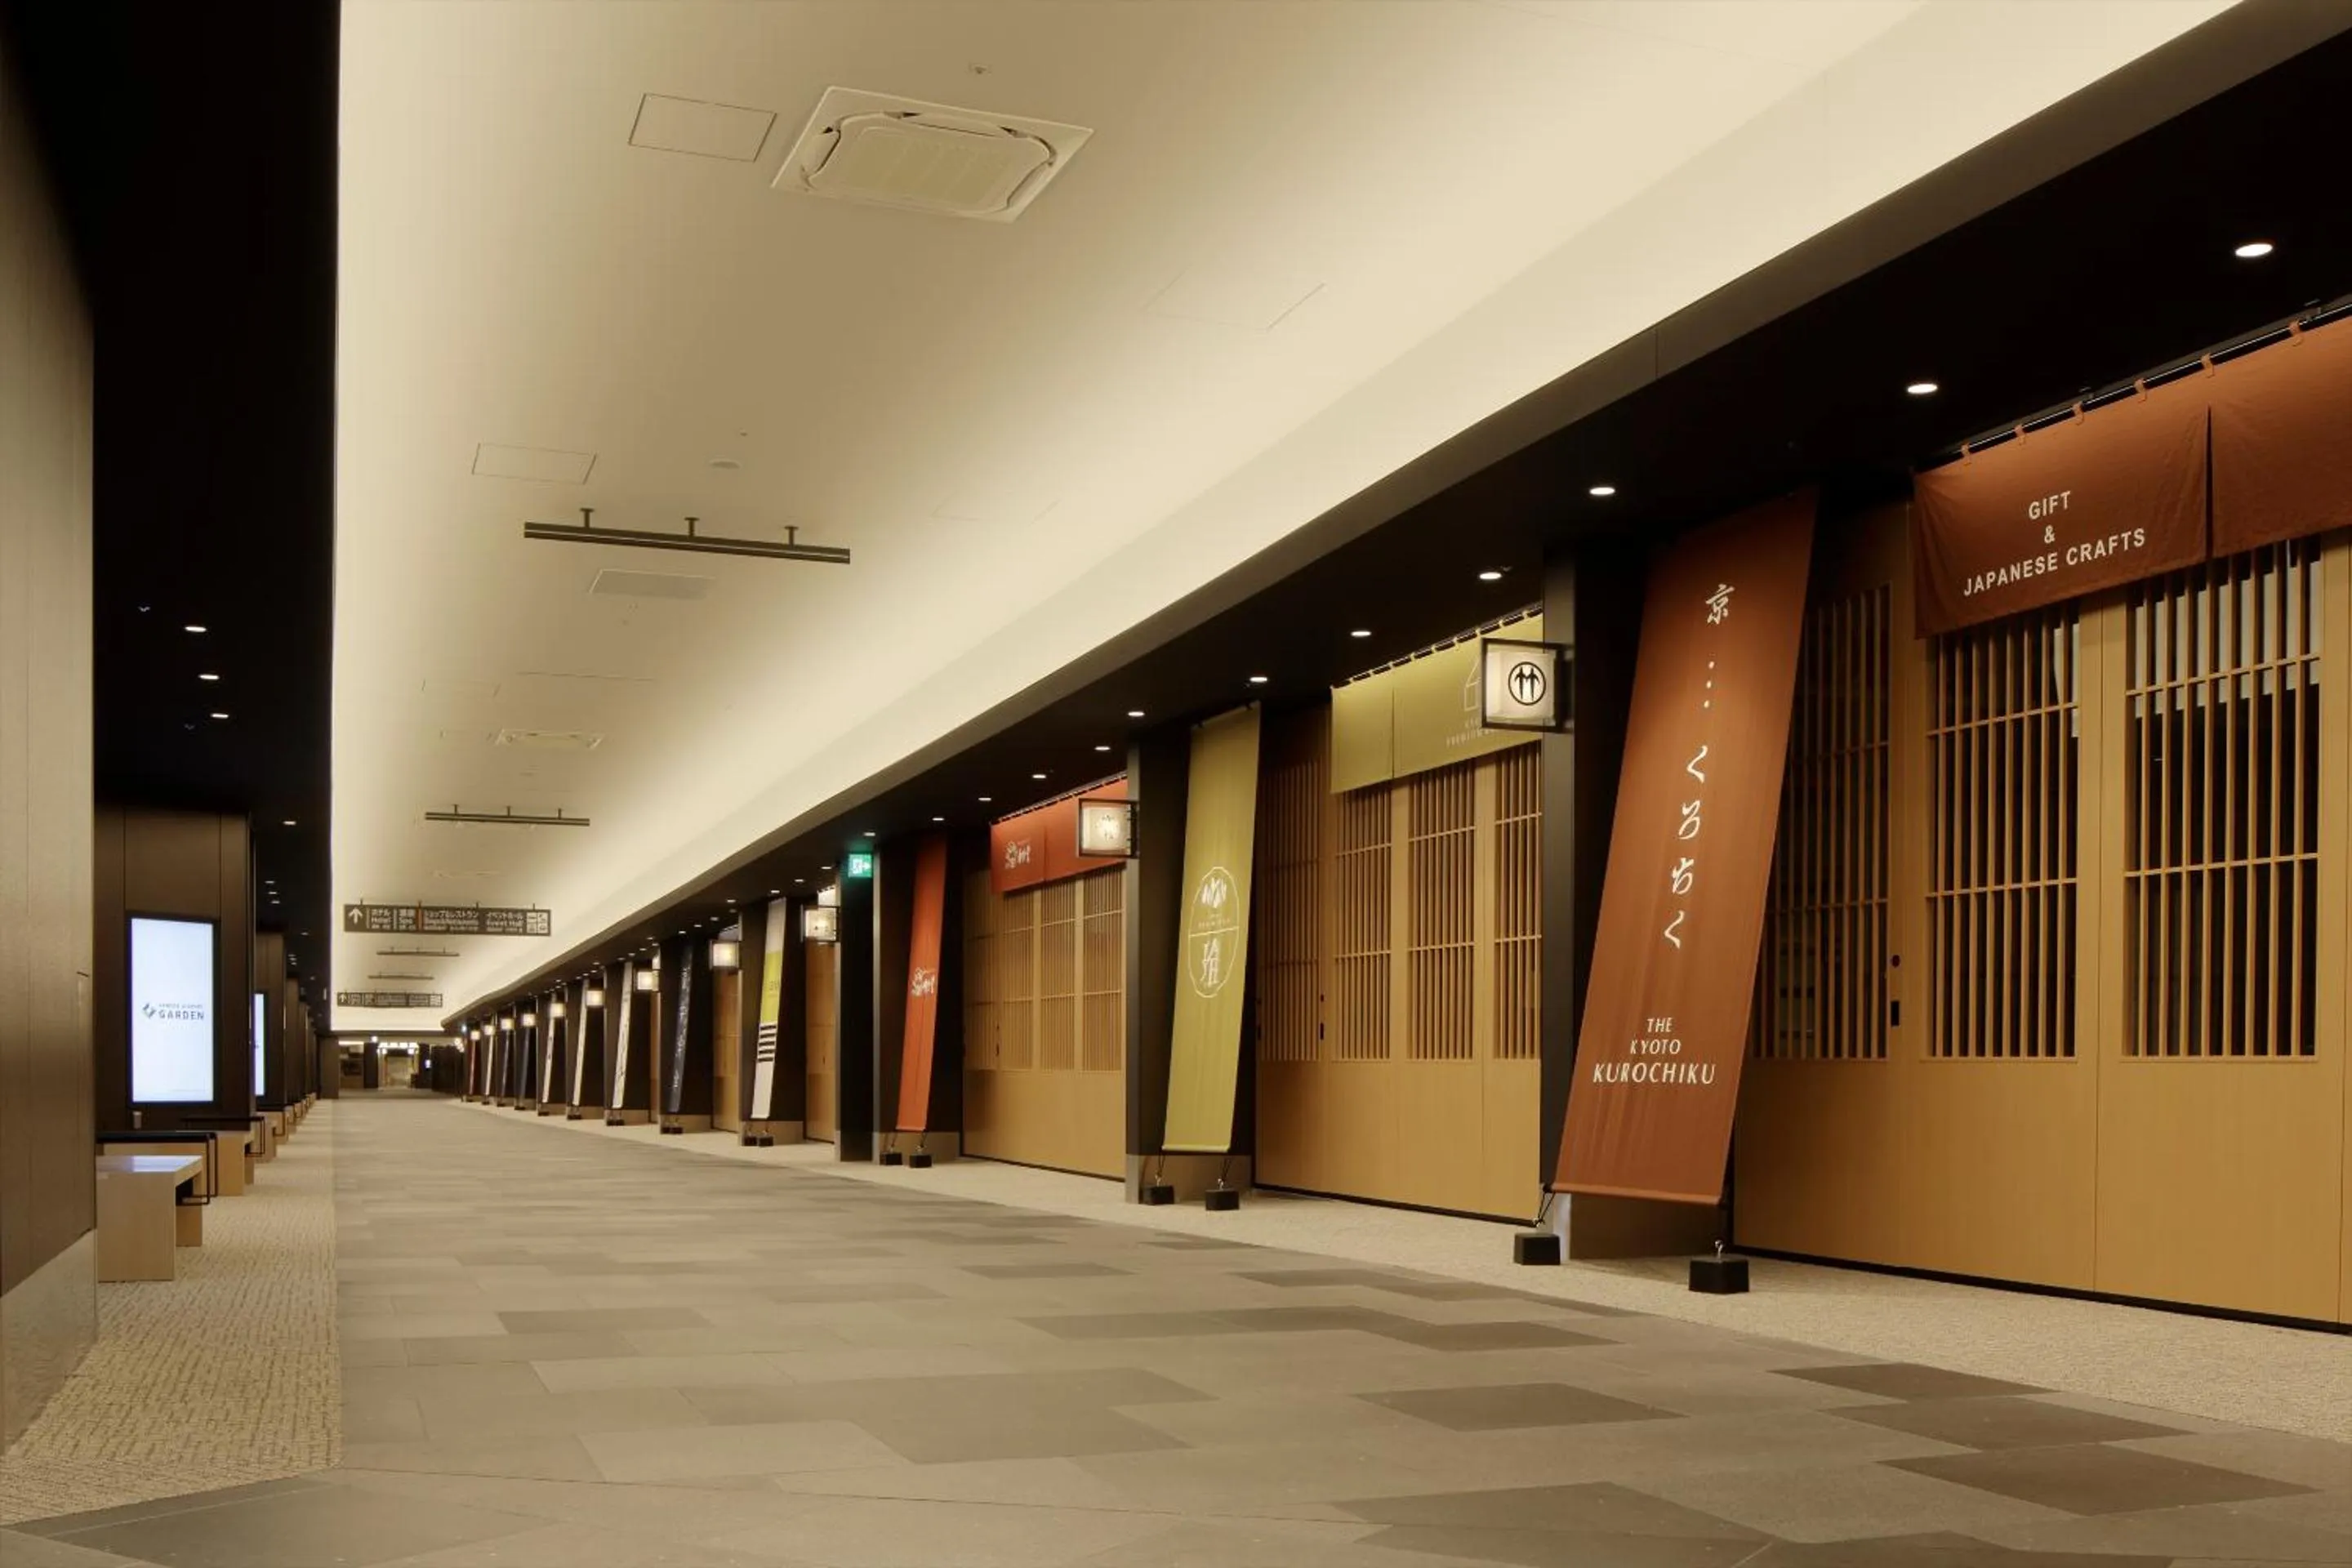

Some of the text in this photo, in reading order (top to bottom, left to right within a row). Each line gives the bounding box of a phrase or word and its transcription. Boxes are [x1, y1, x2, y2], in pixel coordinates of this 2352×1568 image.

[2028, 491, 2071, 519] GIFT
[2043, 524, 2056, 544] &
[1963, 528, 2146, 596] JAPANESE CRAFTS
[158, 1009, 204, 1020] GARDEN
[1646, 1017, 1673, 1033] THE
[1630, 1039, 1682, 1054] KYOTO
[1592, 1062, 1717, 1085] KUROCHIKU
